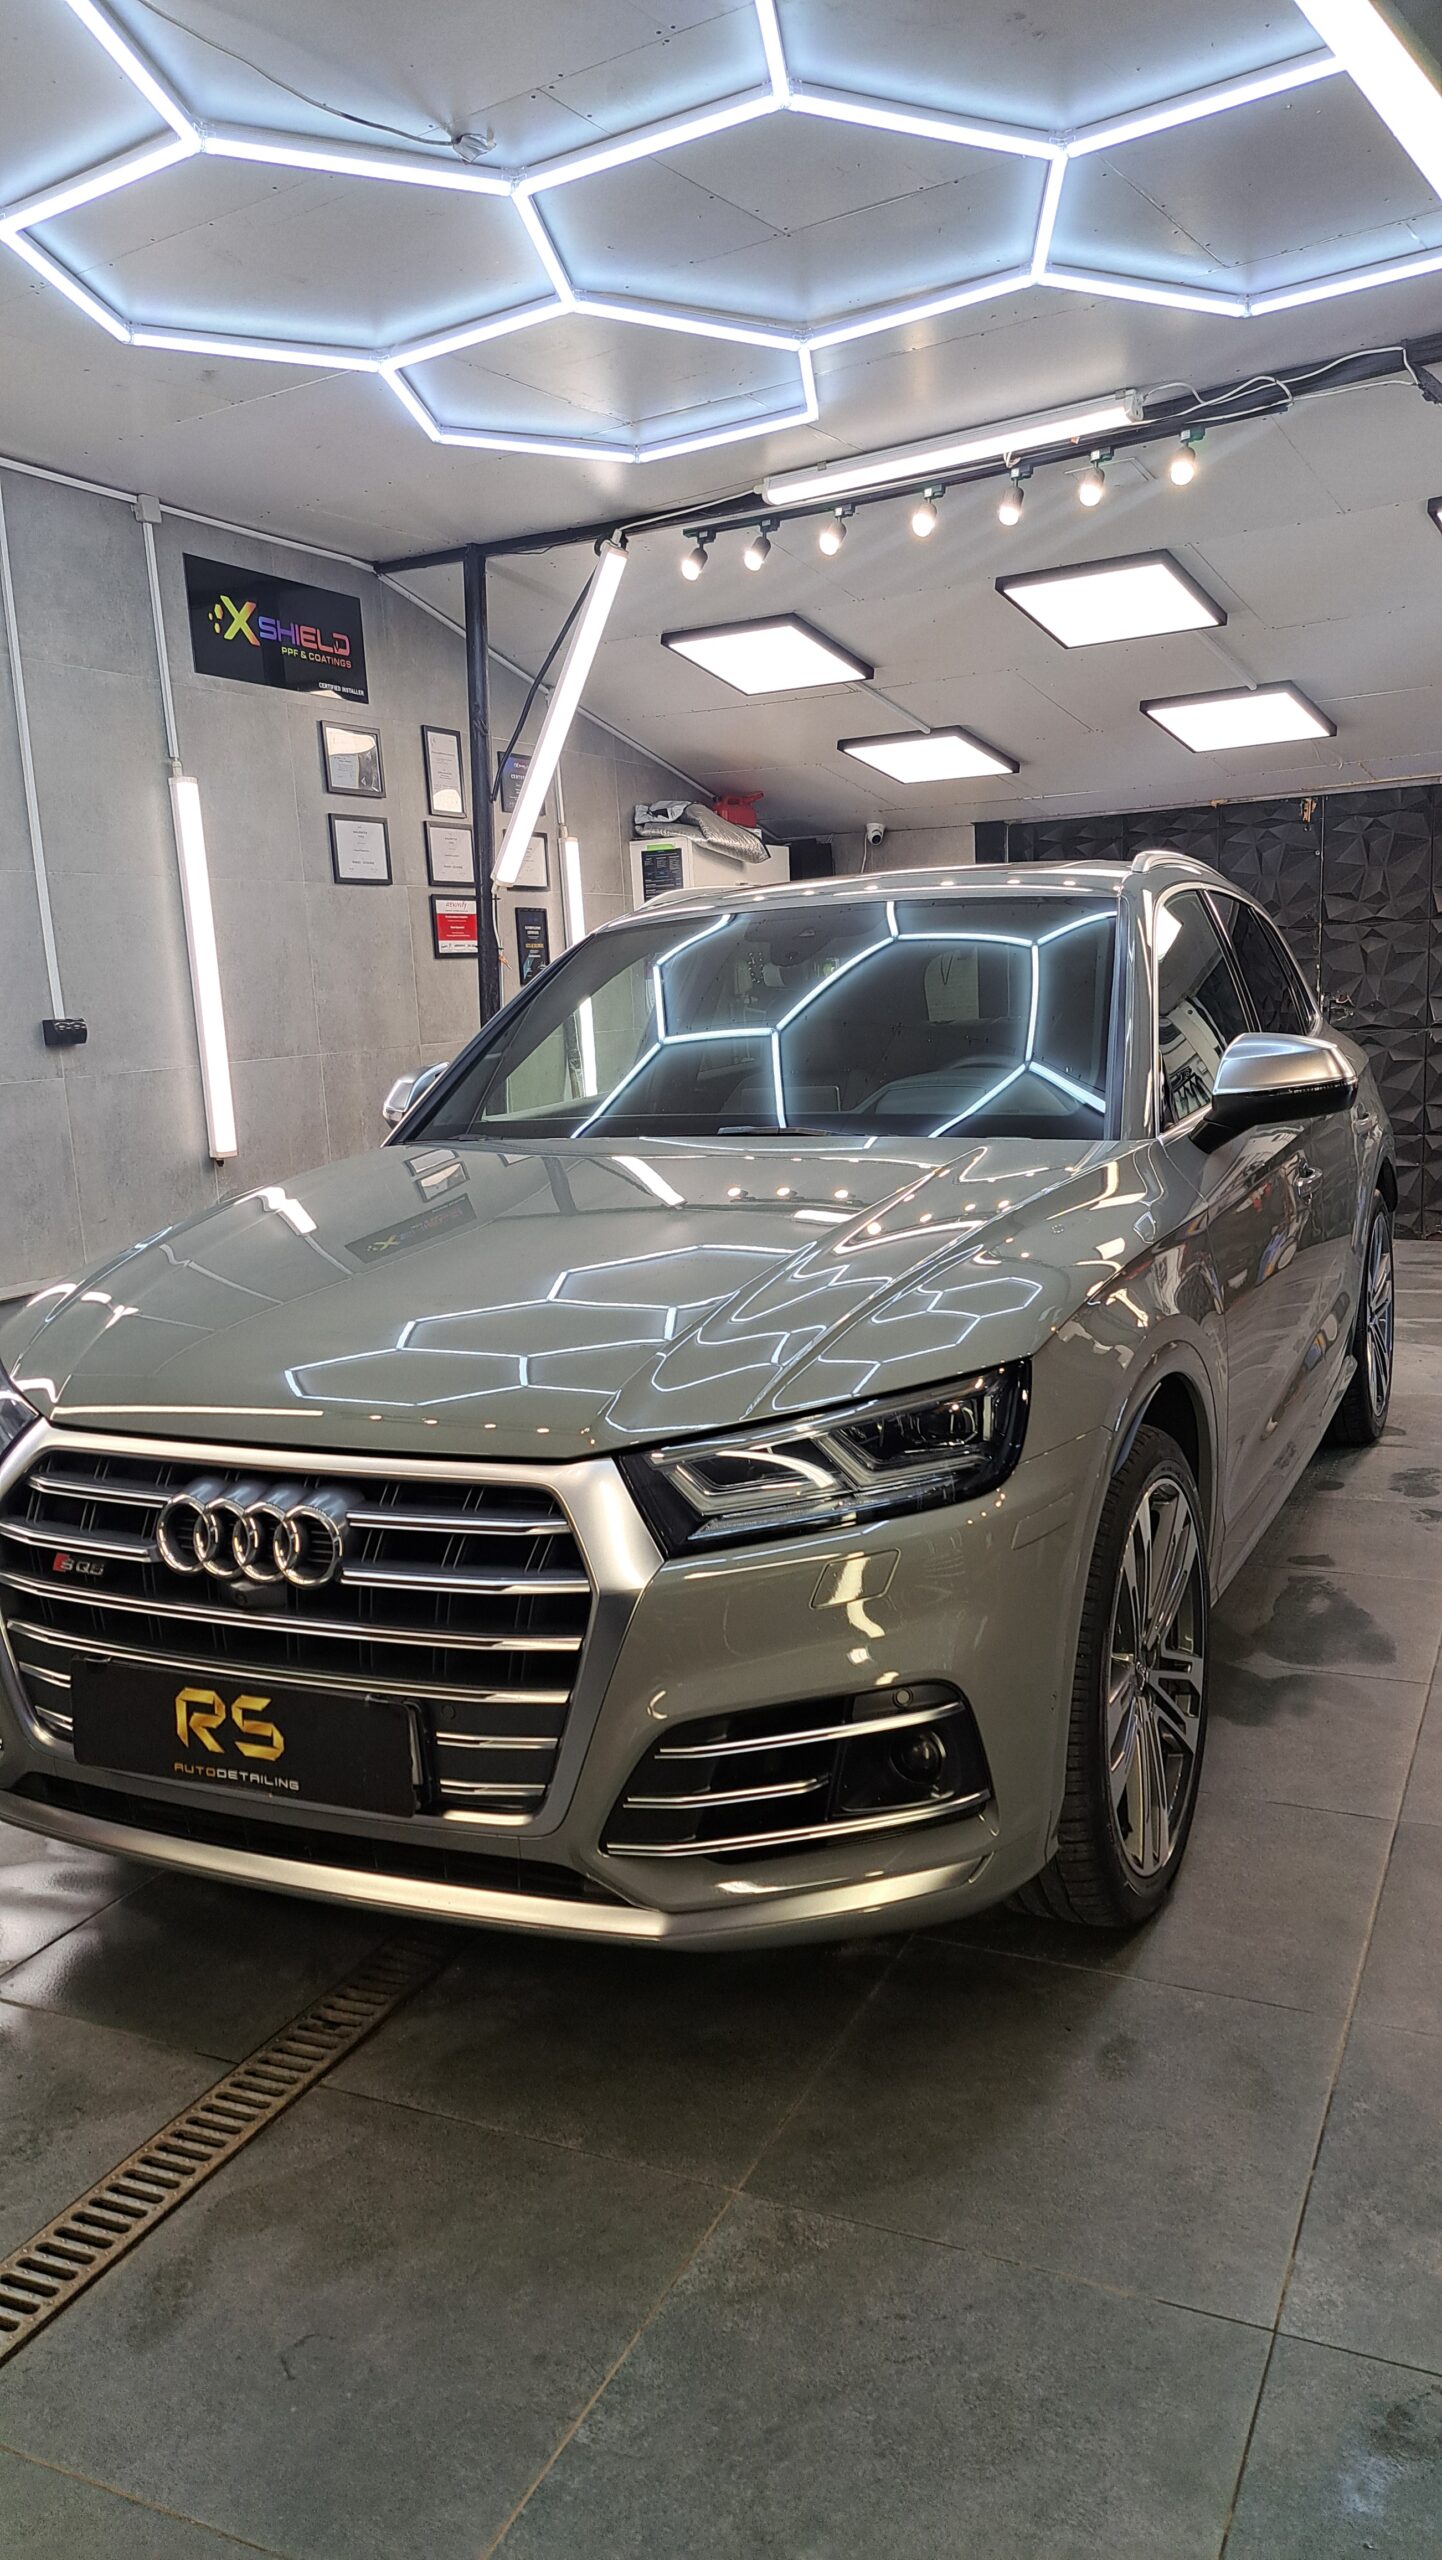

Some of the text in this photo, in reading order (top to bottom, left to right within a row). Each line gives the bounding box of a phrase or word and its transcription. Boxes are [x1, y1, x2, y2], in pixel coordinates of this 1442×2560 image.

[281, 646, 352, 669] PPF & COATINGS
[175, 1687, 285, 1762] RS
[174, 1762, 300, 1791] AUTODETAILING
